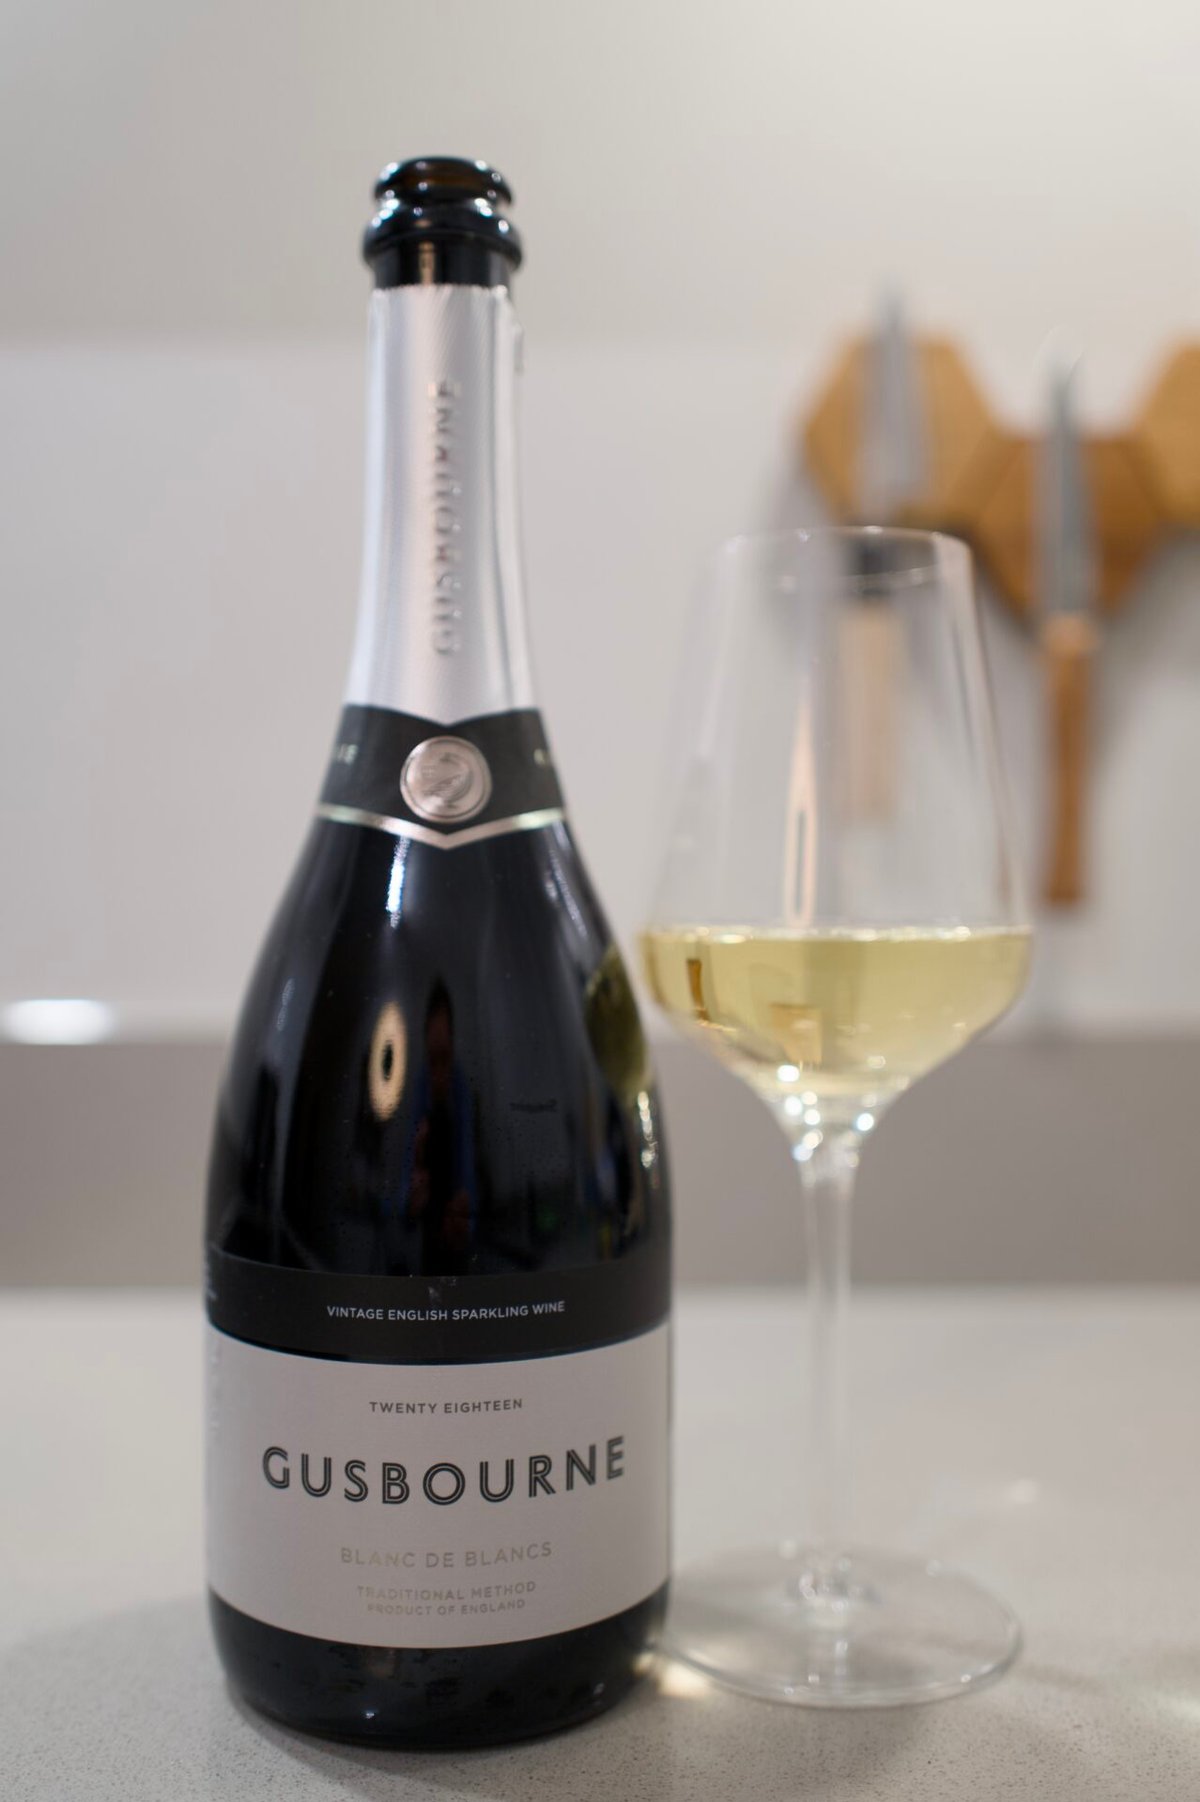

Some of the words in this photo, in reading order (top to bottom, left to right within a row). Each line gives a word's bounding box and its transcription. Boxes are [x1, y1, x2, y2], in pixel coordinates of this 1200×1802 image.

[326, 1305, 384, 1321] VINTAGE
[388, 1309, 448, 1321] ENGLISH
[452, 1305, 529, 1320] SPARKLING
[532, 1300, 565, 1315] WINE
[369, 1401, 437, 1414] TWENTY
[444, 1397, 523, 1414] EIGHTEEN
[262, 1435, 625, 1506] GUSBOURNE
[341, 1547, 415, 1568] BLANC
[425, 1552, 454, 1568] DE
[465, 1541, 552, 1567] BLANCS
[357, 1585, 465, 1601] TRADITIONAL
[470, 1581, 536, 1598] METHOD
[366, 1603, 432, 1616] PRODUCT
[436, 1604, 456, 1616] OF
[460, 1599, 525, 1615] ENGLAND
